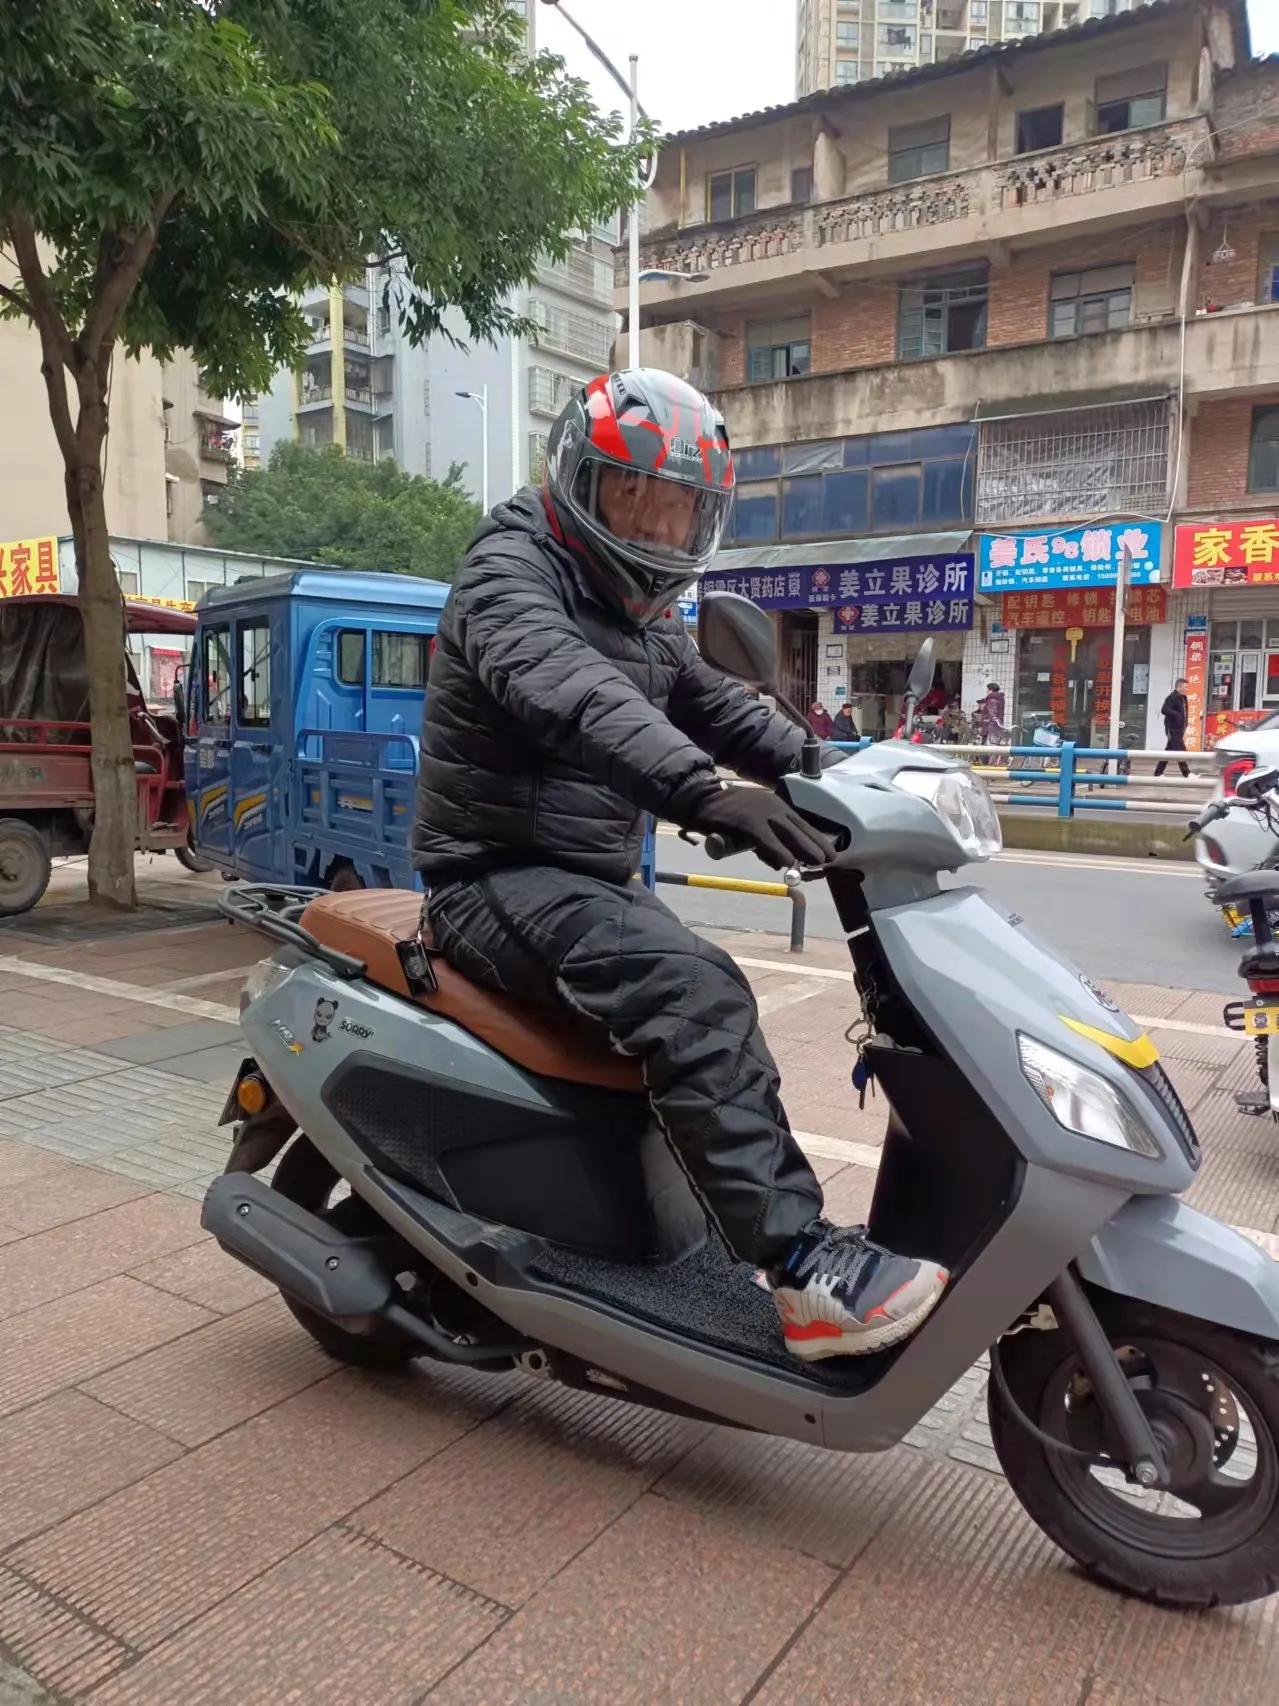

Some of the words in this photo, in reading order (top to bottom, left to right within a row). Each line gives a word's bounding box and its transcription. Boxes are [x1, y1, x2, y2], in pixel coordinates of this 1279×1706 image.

[838, 561, 968, 598] 姜立果诊所
[860, 599, 969, 628] 姜立果诊所
